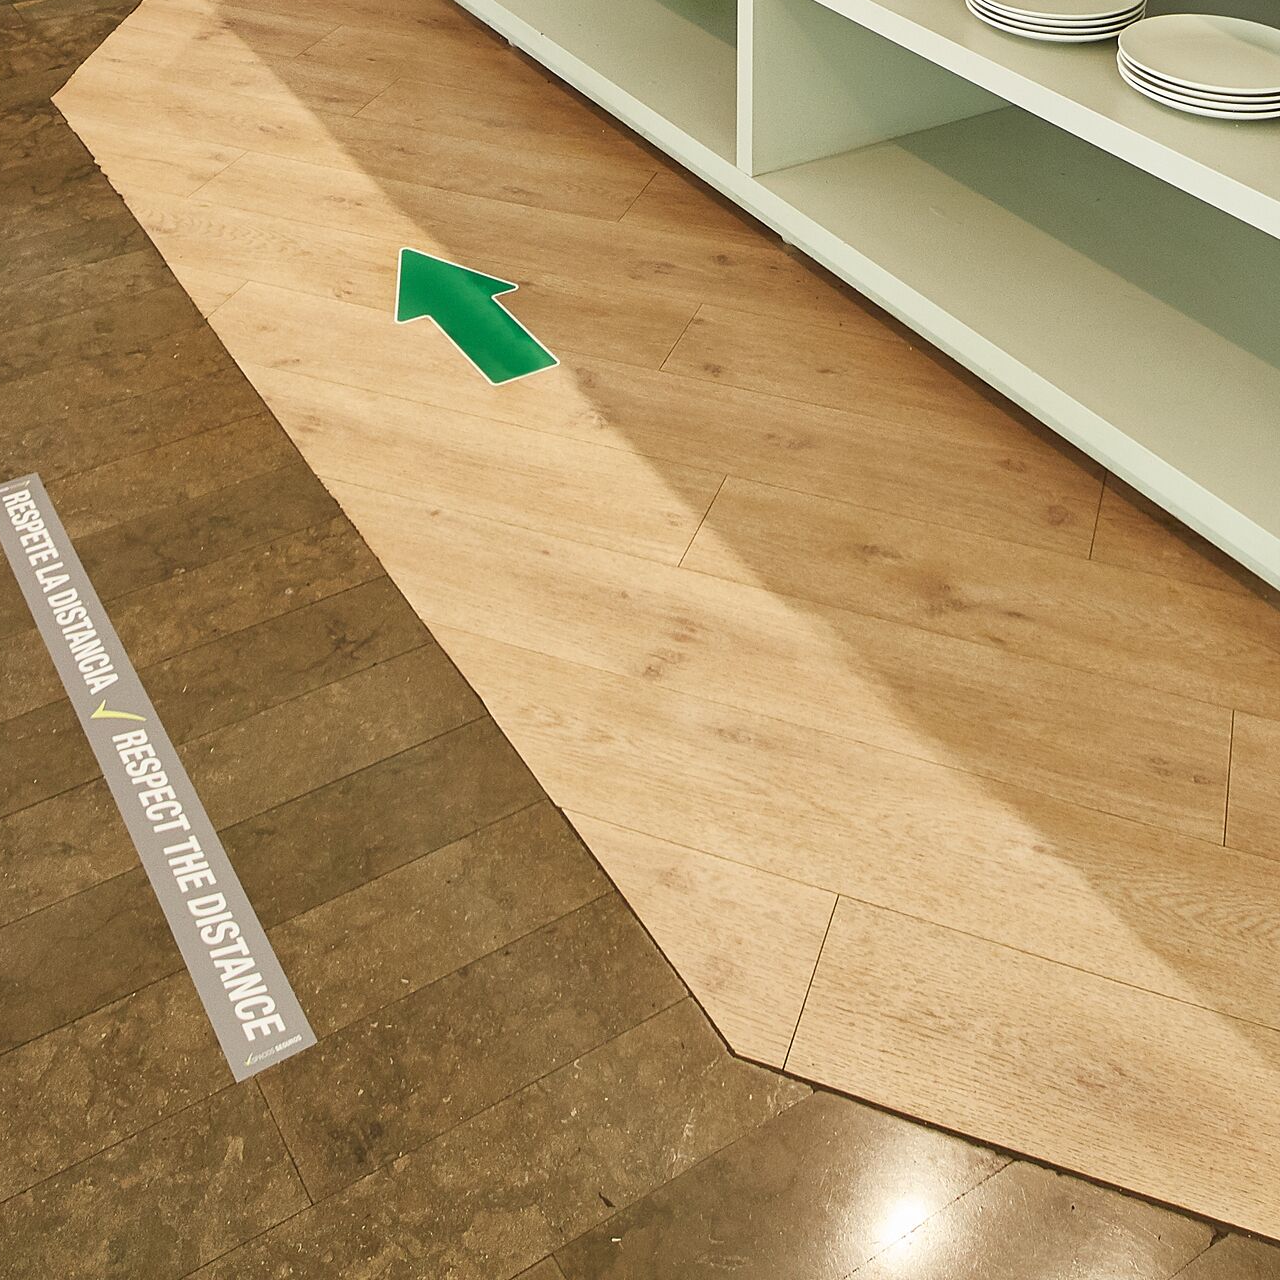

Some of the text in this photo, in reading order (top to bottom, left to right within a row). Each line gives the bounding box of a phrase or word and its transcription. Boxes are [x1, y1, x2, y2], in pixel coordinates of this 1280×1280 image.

[2, 489, 60, 567] RESPETE
[35, 561, 71, 593] LA
[47, 587, 119, 696] DISTANCIA
[111, 728, 287, 1042] RESPECT THE DISTANCE
